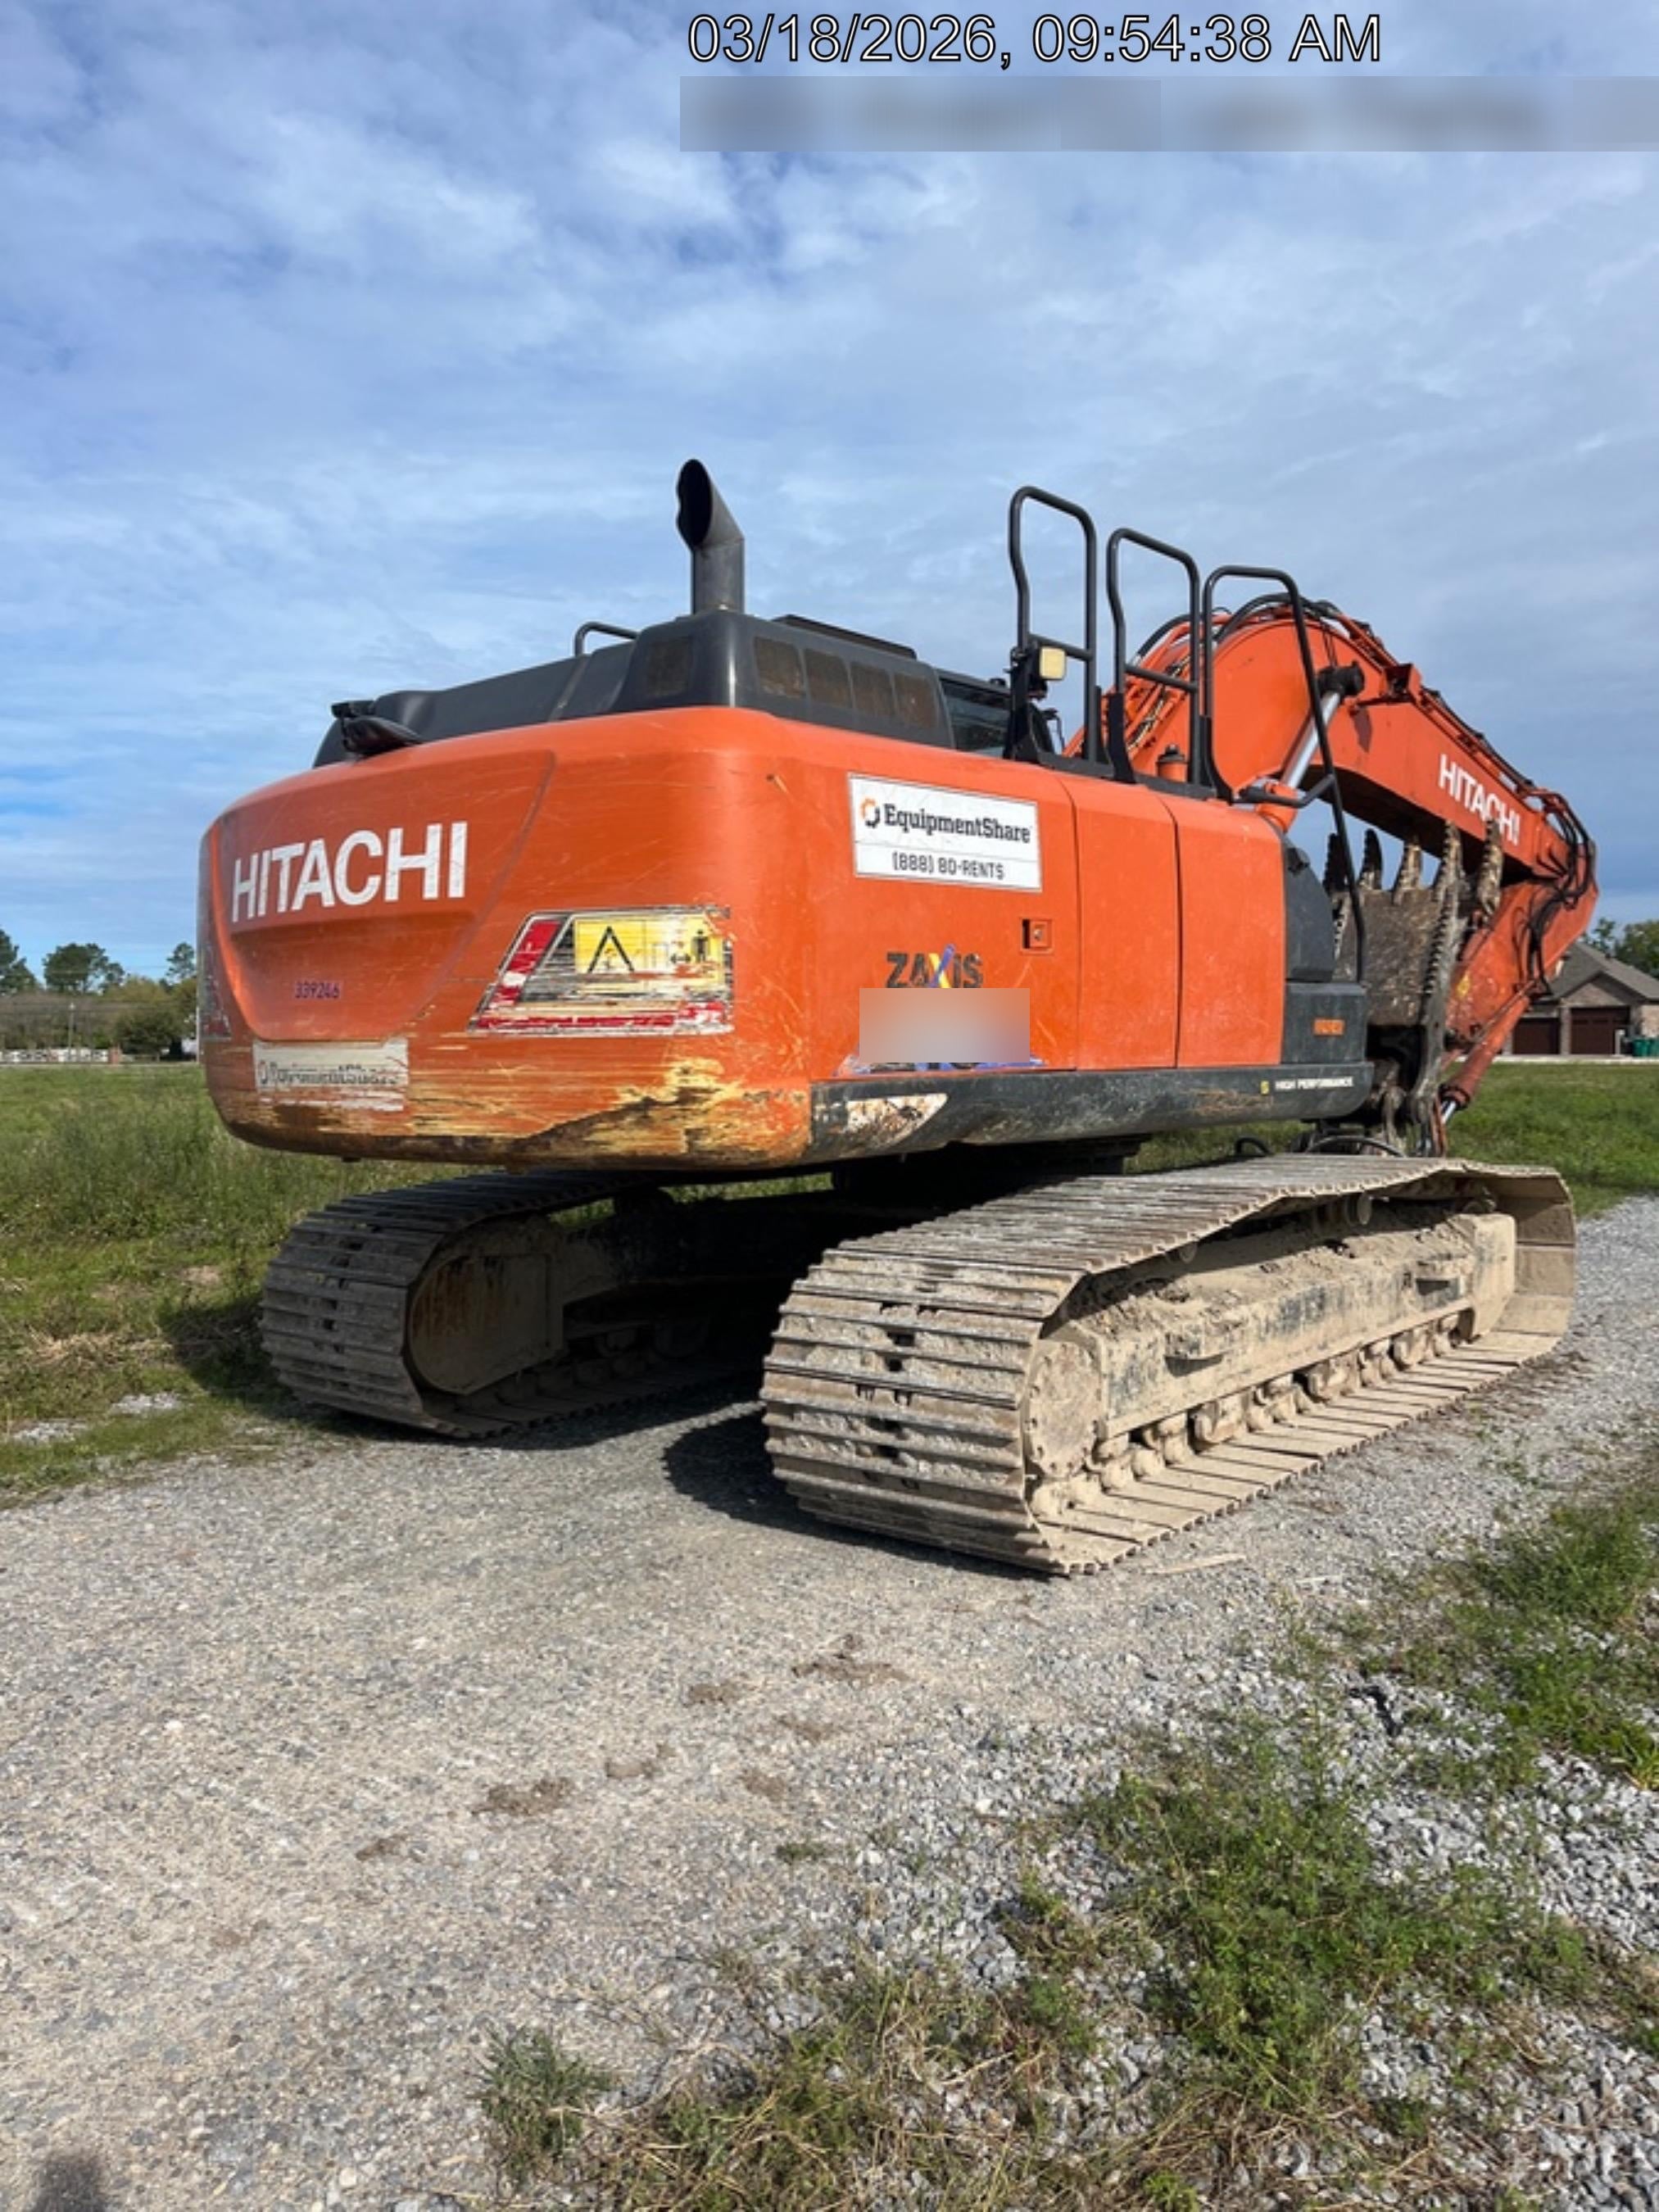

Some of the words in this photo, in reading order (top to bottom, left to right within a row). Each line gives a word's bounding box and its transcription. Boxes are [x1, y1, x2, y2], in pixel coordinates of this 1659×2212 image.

[1439, 753, 1520, 846] HITACHI
[883, 803, 1031, 845] EquipmentShare
[232, 822, 468, 923] HITACHI
[892, 850, 933, 875] (888)
[886, 944, 984, 989] ZAXIS
